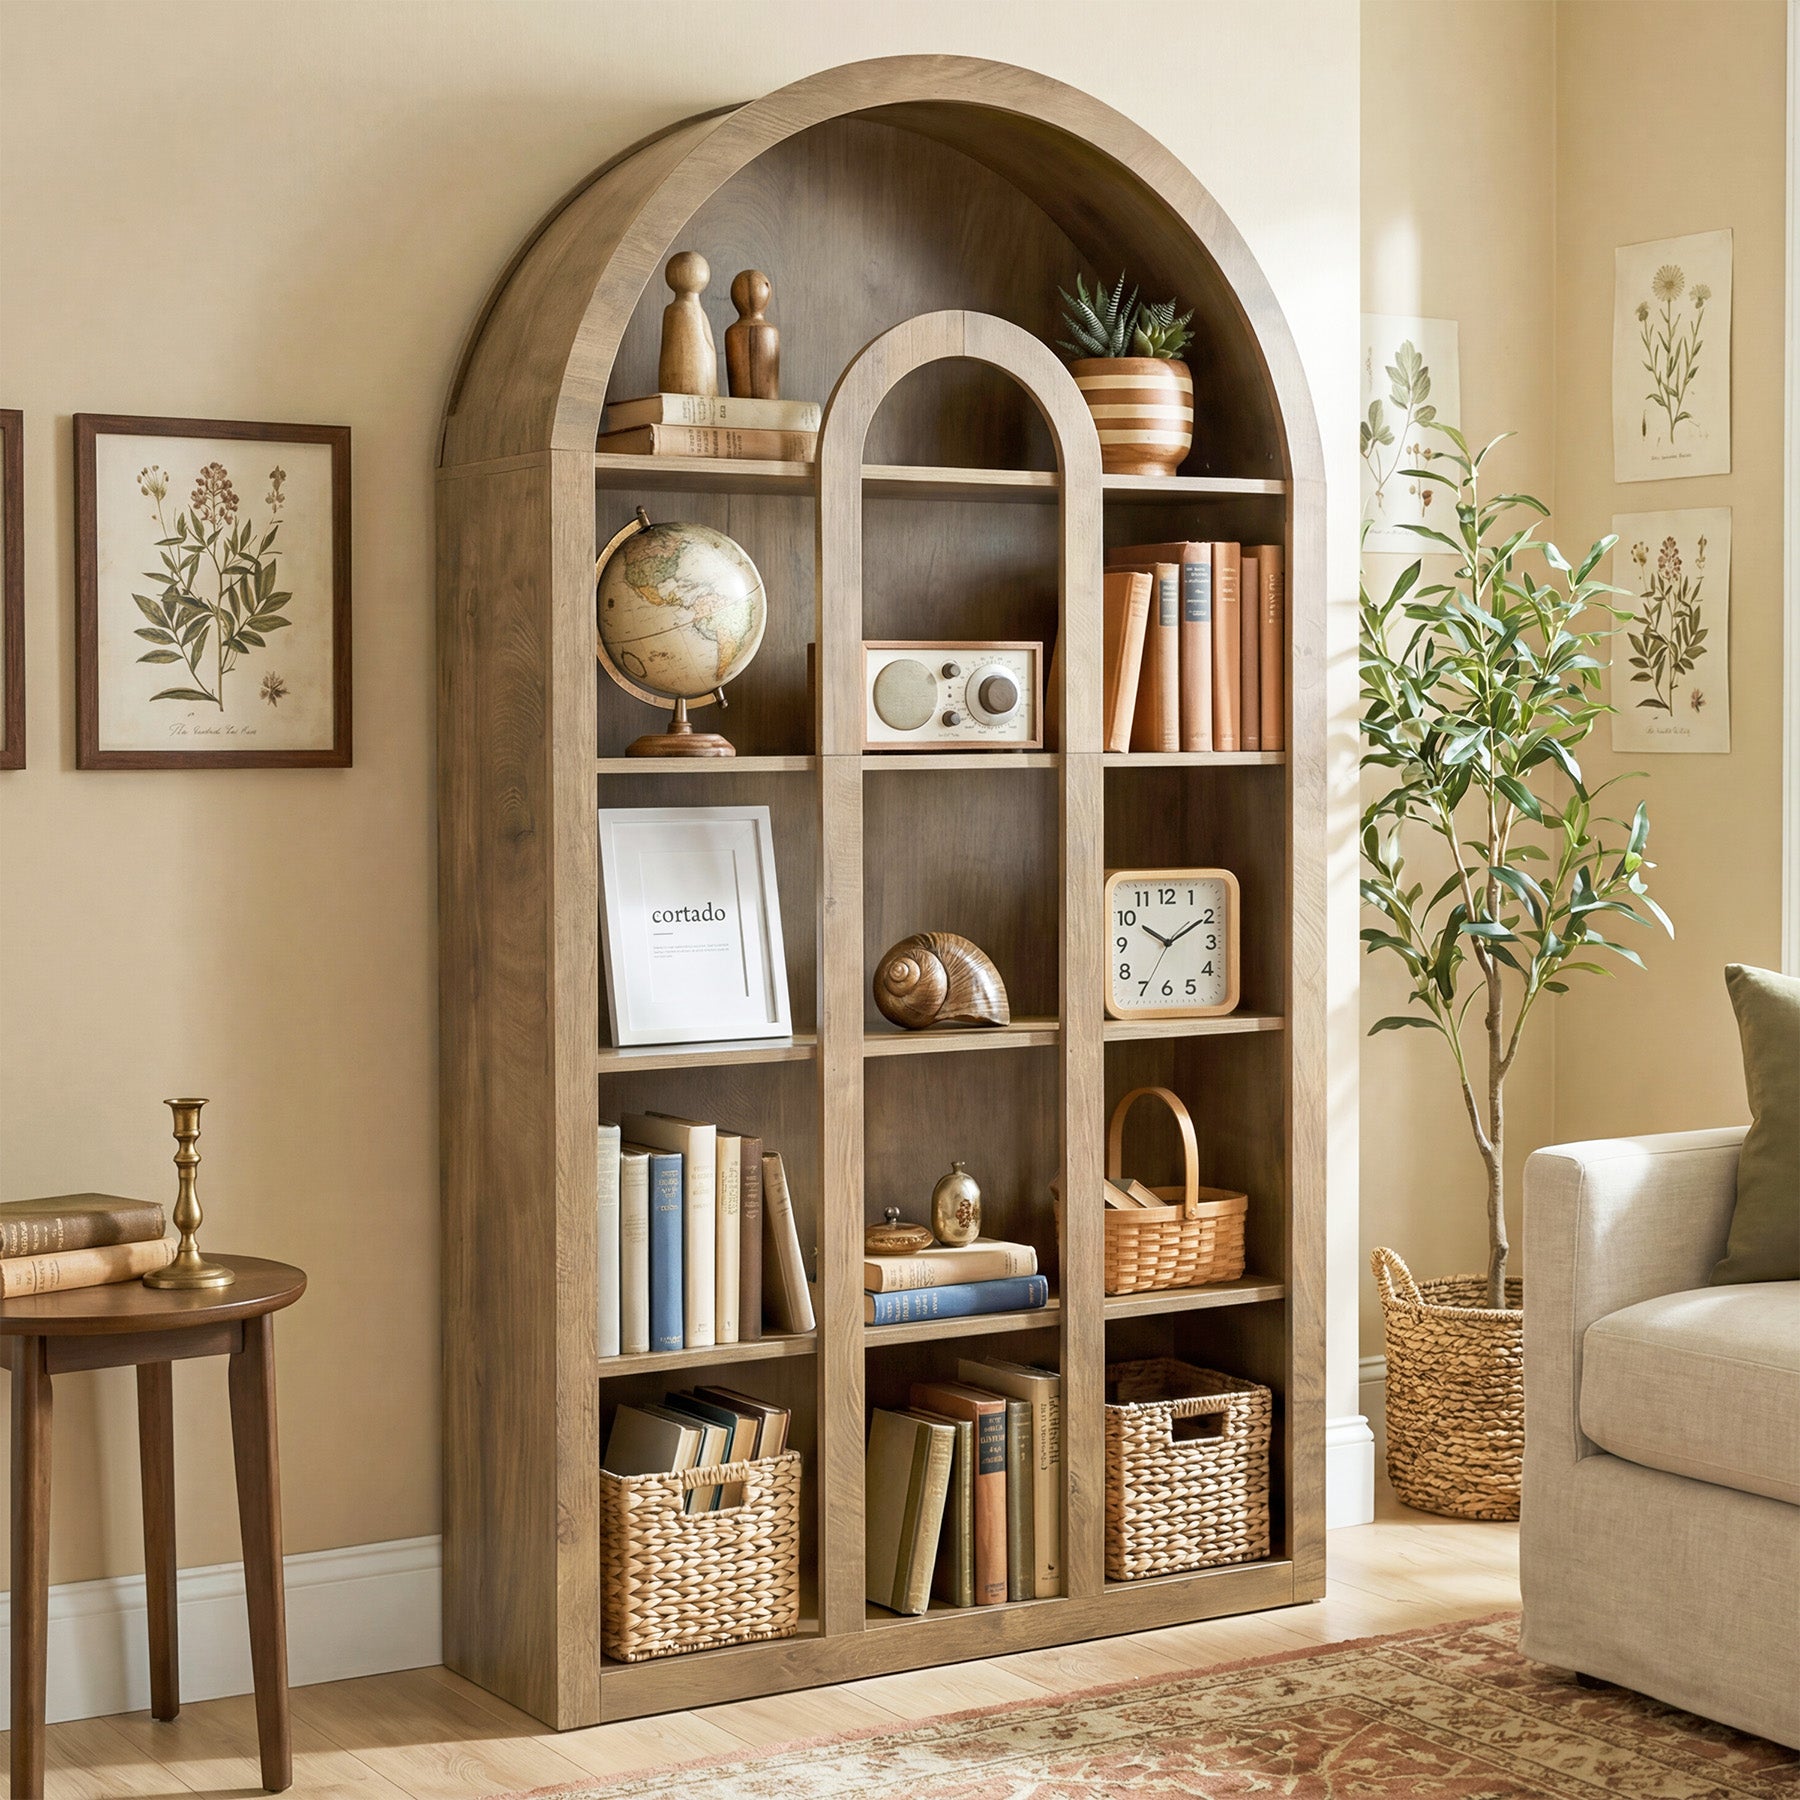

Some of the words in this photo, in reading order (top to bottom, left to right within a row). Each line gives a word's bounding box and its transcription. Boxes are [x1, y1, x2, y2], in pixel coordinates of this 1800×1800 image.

[1135, 891, 1149, 907] 11
[1158, 889, 1176, 905] 12
[1188, 890, 1194, 905] 1
[652, 902, 726, 924] cortado
[1117, 910, 1136, 926] 10
[1203, 909, 1214, 924] 2
[1117, 937, 1127, 953] 9
[1205, 935, 1217, 950] 3
[1119, 963, 1131, 980] 8
[1201, 961, 1214, 976] 4
[1138, 981, 1148, 996] 7
[1161, 980, 1173, 996] 6
[1185, 979, 1196, 995] 5
